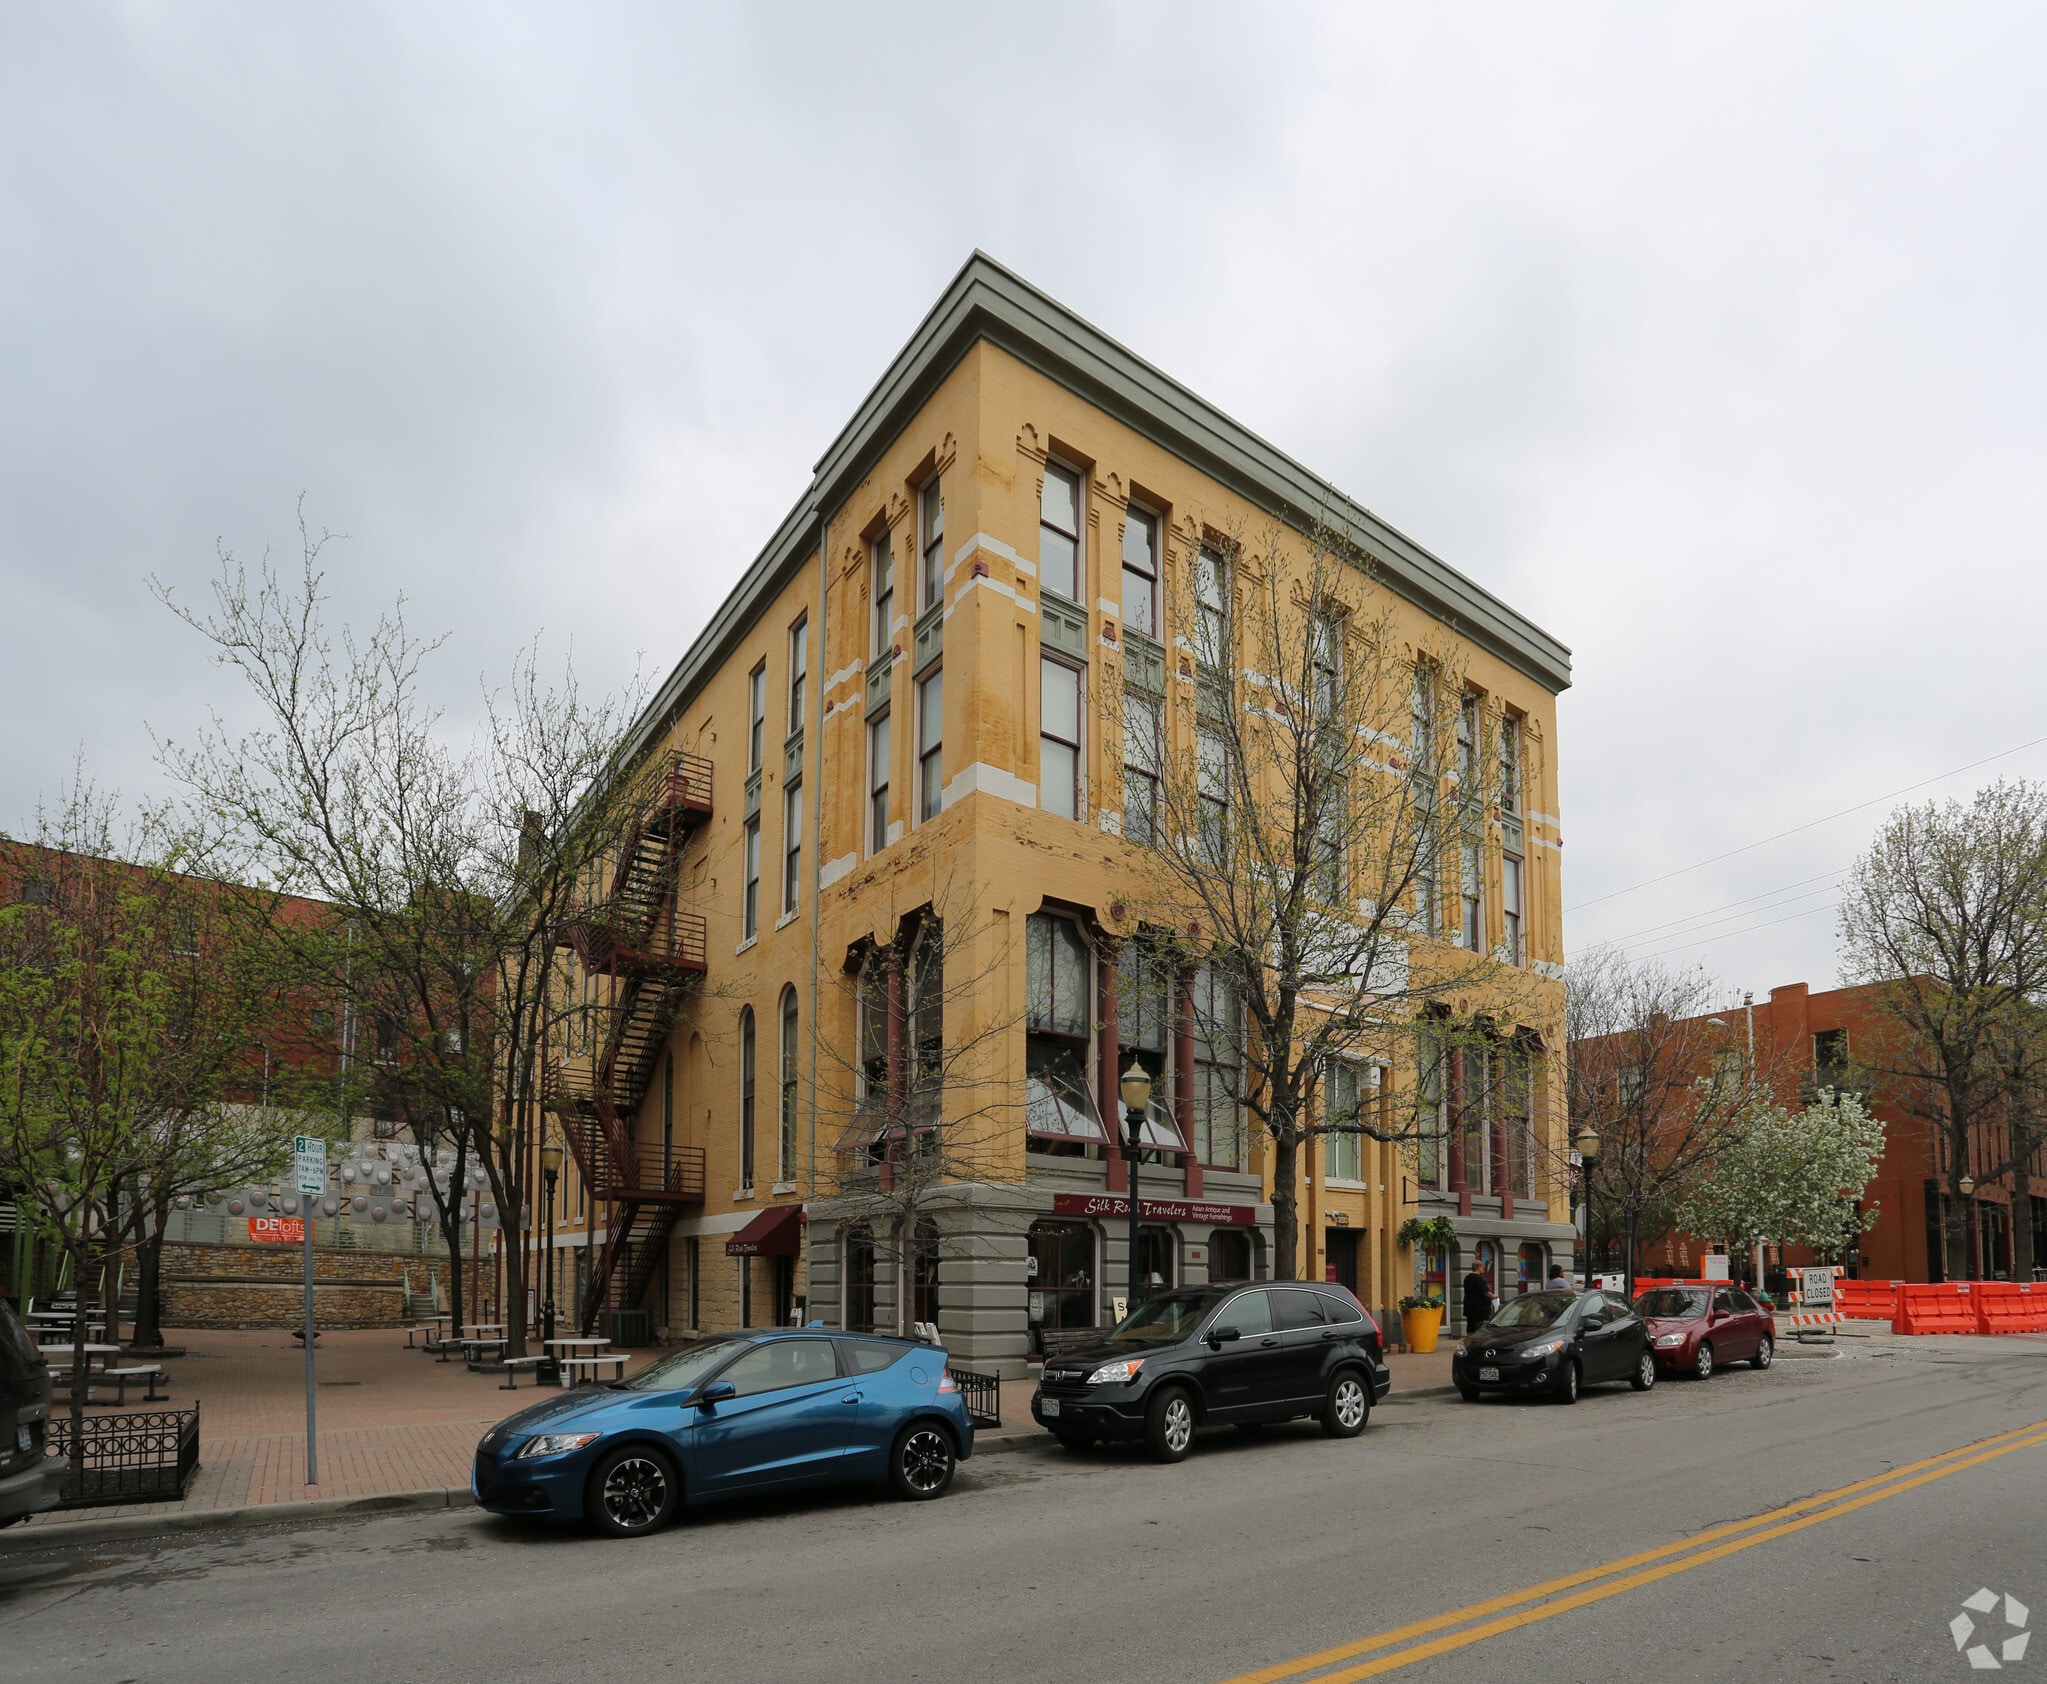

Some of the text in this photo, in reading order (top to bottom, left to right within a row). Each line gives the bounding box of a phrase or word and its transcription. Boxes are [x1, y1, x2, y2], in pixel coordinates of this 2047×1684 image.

[298, 1140, 322, 1153] 2 HOUR
[298, 1155, 323, 1165] PARKING
[298, 1165, 324, 1174] 7AM-6PM
[1084, 1198, 1110, 1214] Silk
[1143, 1202, 1187, 1217] Travelers
[1205, 1206, 1221, 1214] Antique
[1192, 1212, 1233, 1223] Vintage Furnishings
[1809, 1273, 1827, 1284] ROAD
[1806, 1286, 1830, 1299] CLOSED
